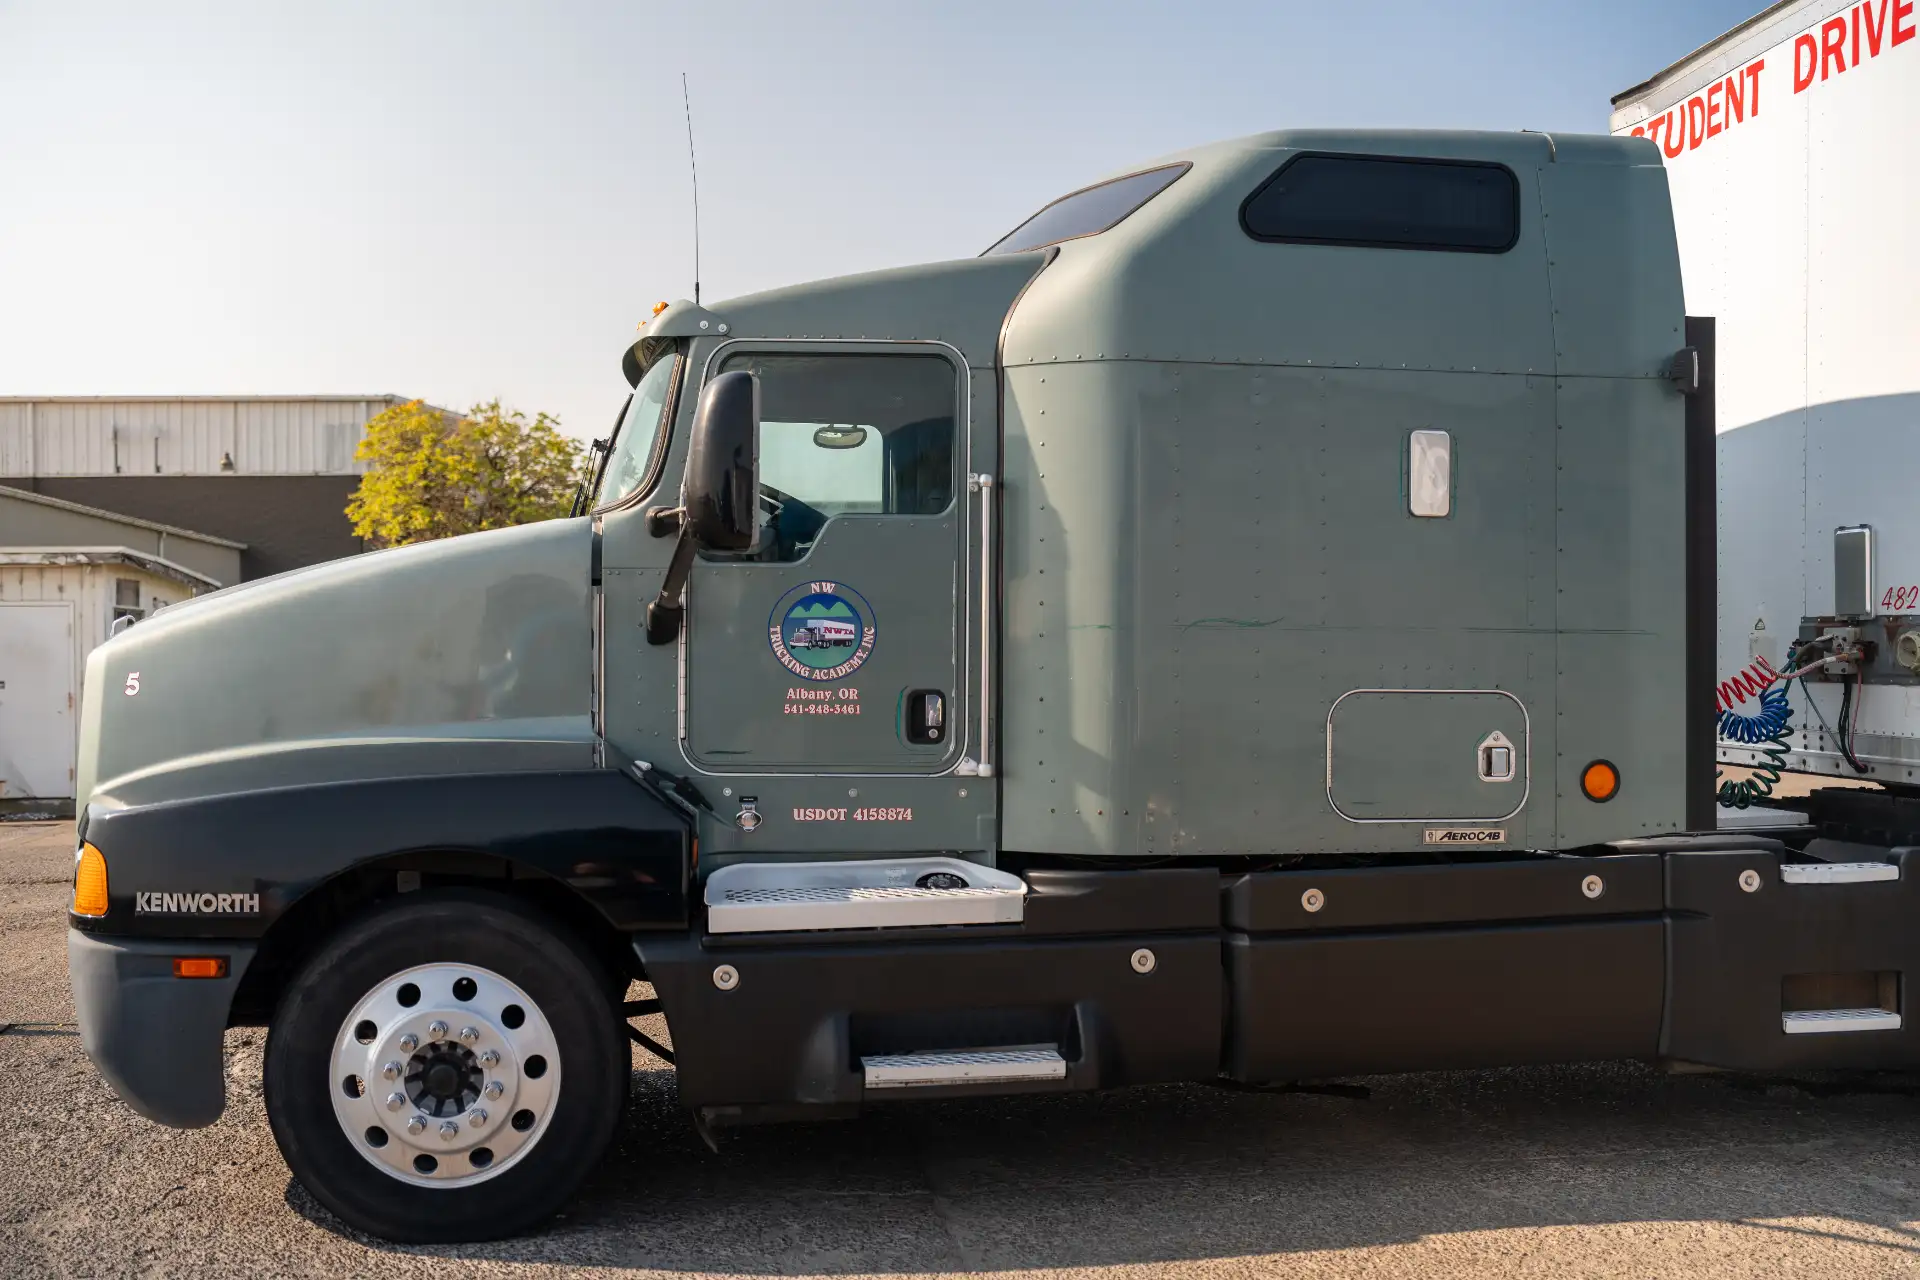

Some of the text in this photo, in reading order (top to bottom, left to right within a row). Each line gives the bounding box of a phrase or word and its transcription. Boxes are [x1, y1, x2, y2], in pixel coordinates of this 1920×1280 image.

[1794, 0, 1916, 94] DRIVE
[810, 581, 836, 594] NW
[1881, 585, 1919, 611] 482
[823, 626, 855, 635] NWTA
[769, 625, 810, 679] TRUCKING
[124, 672, 140, 696] 5
[786, 688, 858, 701] Albany, OR
[784, 704, 861, 714] 541-248-3461
[793, 808, 912, 821] USDOT 4158874
[1439, 831, 1501, 841] AEROCAB
[135, 892, 260, 913] KENWORTH
